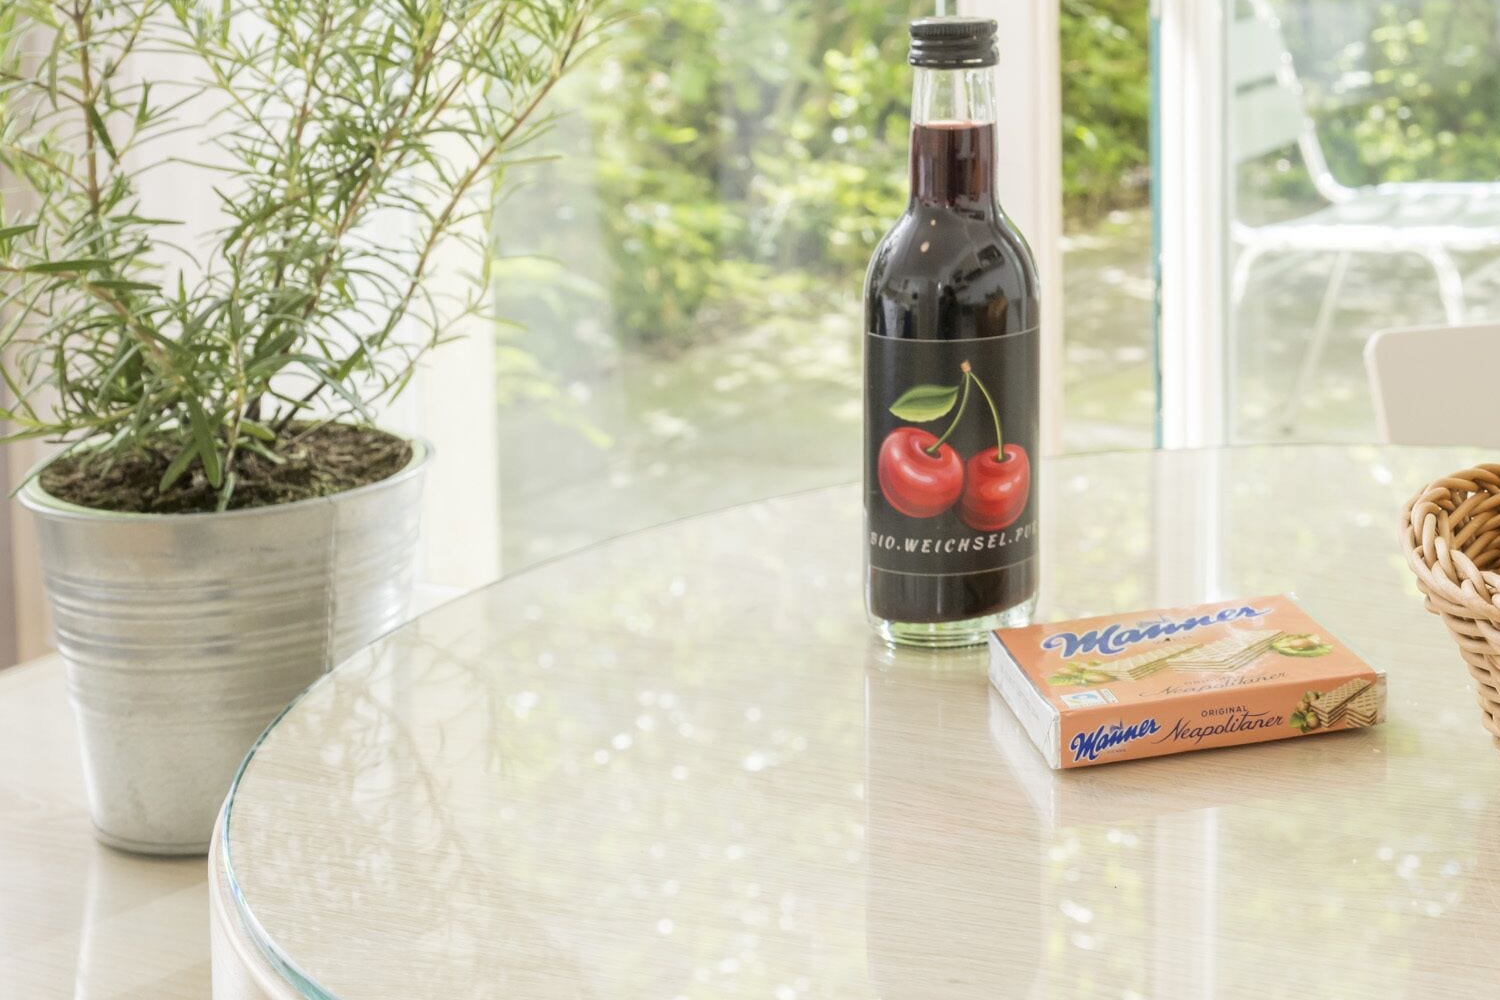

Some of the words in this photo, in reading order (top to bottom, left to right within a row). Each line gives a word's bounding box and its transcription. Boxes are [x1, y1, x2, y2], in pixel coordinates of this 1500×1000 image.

[1042, 605, 1272, 659] Manner
[1151, 710, 1284, 745] Neapolitaner
[1201, 705, 1249, 718] ORIGINAL
[1070, 718, 1162, 762] Manner
